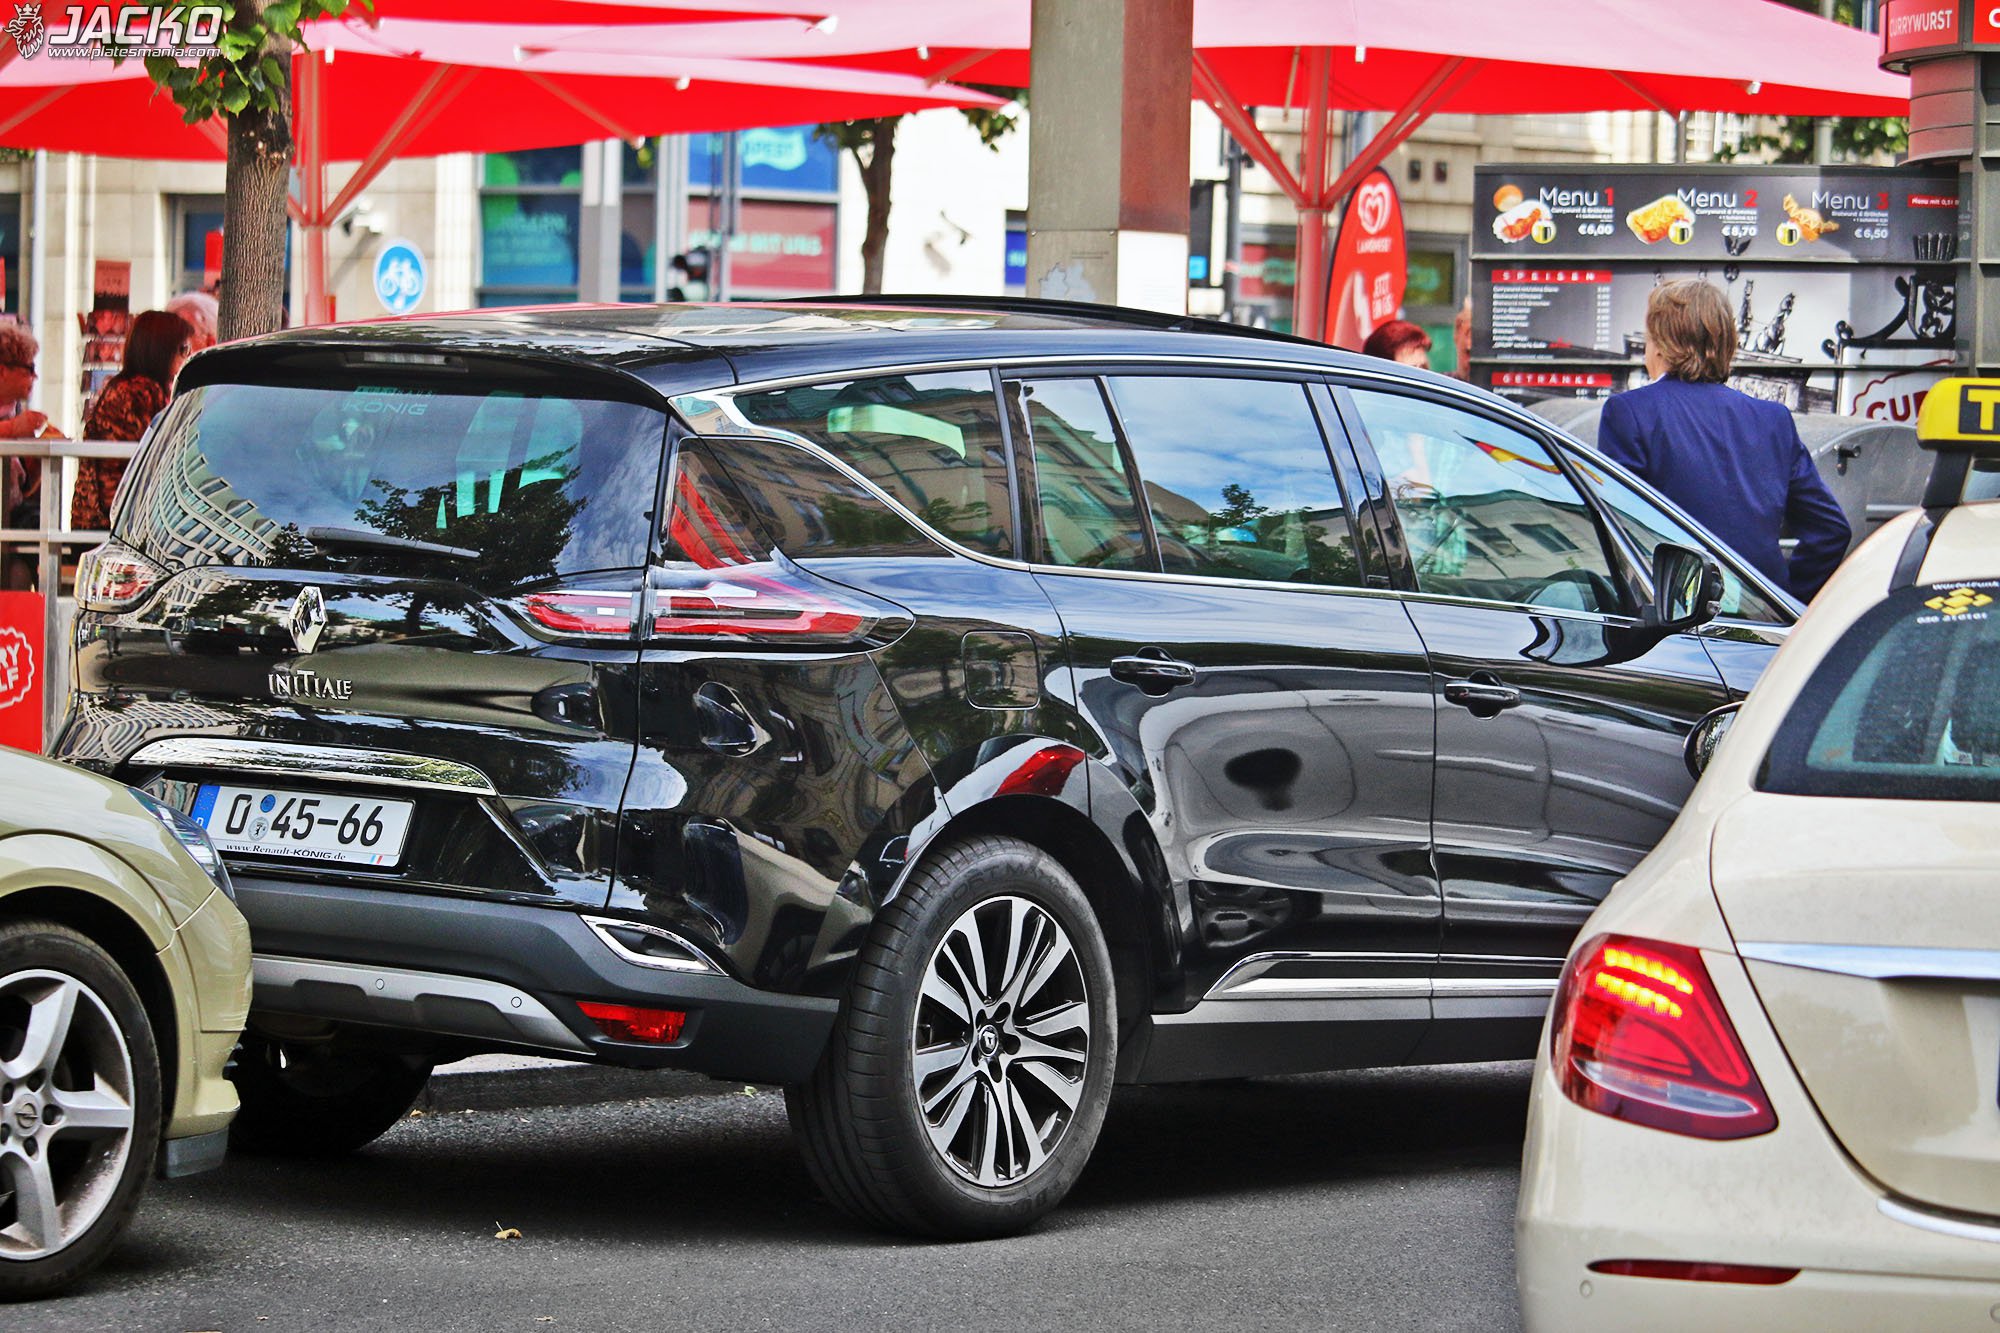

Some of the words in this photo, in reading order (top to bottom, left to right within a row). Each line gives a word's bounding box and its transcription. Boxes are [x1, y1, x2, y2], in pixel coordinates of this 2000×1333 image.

[1889, 9, 1953, 37] CURRYWURST
[1539, 186, 1599, 207] Menu
[1604, 187, 1615, 206] 1
[1677, 187, 1737, 208] Menu
[1743, 189, 1758, 208] 2
[1811, 191, 1870, 210] Menu
[1876, 192, 1889, 211] 3
[1502, 271, 1595, 281] SPEISEN
[1503, 374, 1595, 385] GETRÄNKE
[268, 670, 353, 700] INITIALE
[271, 797, 384, 847] 45-66
